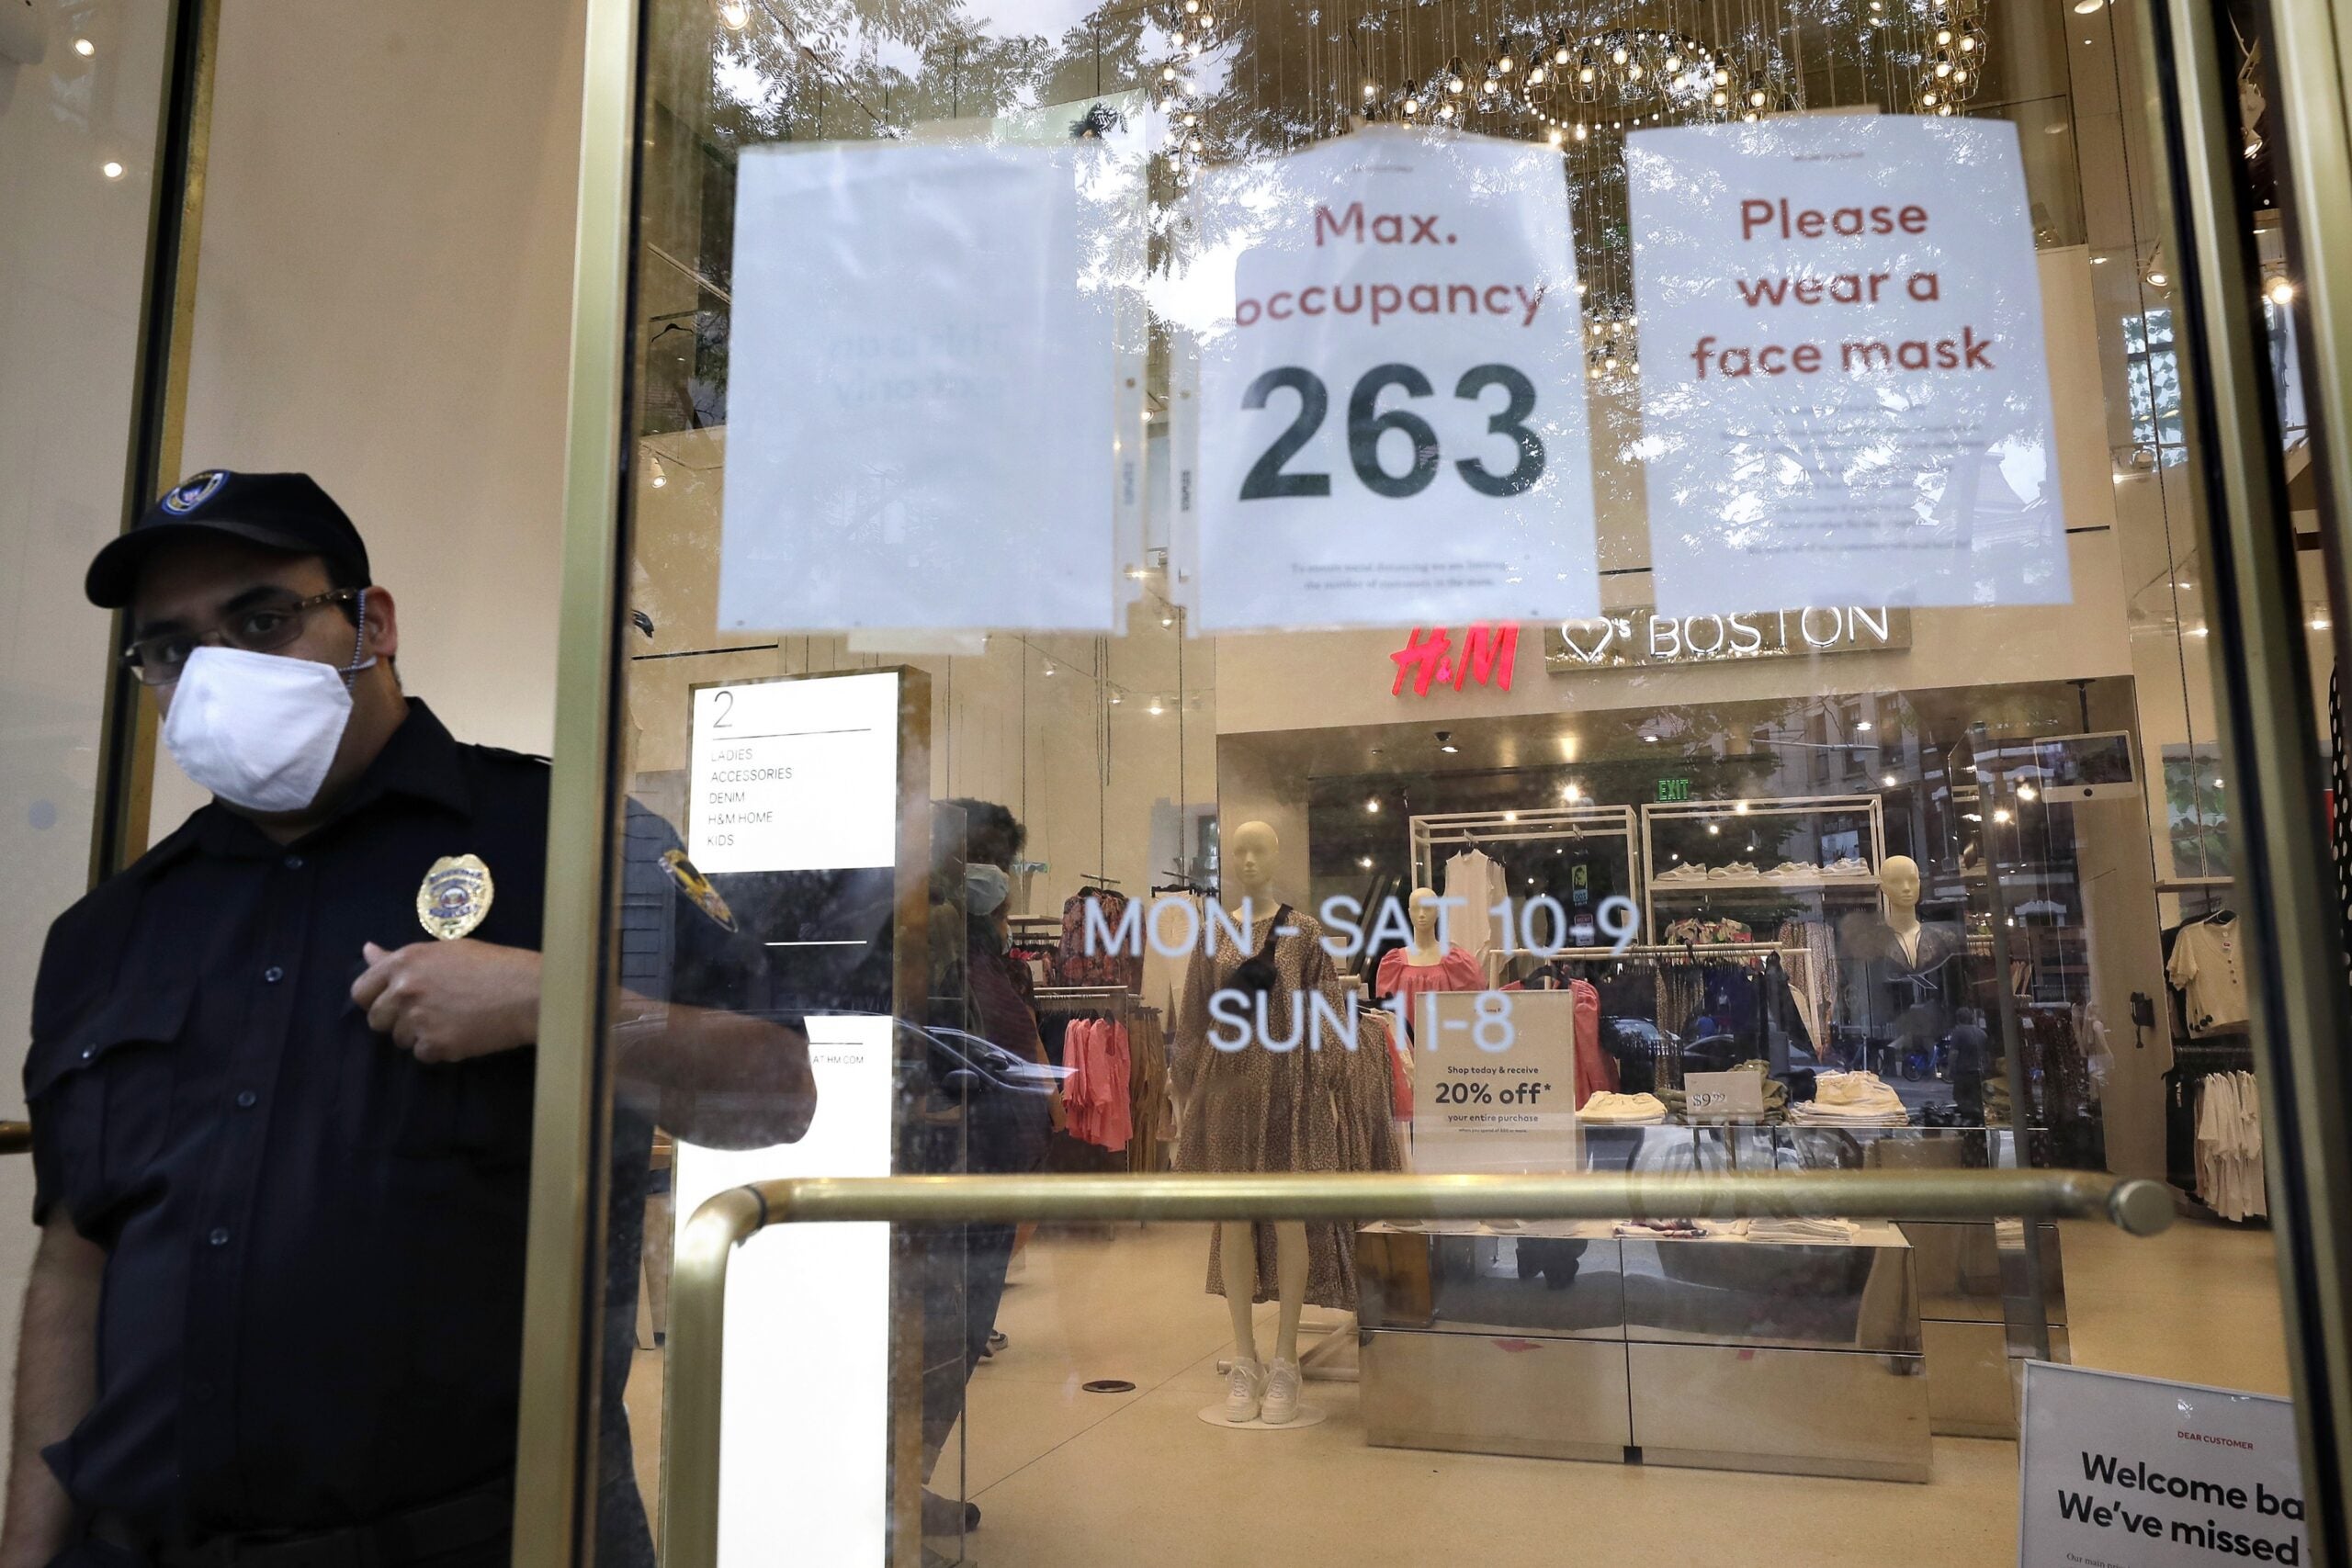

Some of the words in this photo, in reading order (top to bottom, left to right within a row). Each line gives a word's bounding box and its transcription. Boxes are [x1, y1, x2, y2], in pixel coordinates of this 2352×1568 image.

[1314, 201, 1458, 247] Max.
[1739, 198, 1928, 241] Please
[1736, 268, 1890, 310] wear
[1907, 271, 1940, 302] a
[1235, 281, 1545, 328] occupancy
[1690, 335, 1822, 380] face
[1842, 326, 1997, 372] mask
[1238, 361, 1545, 502] 263
[1390, 620, 1521, 697] H&M
[713, 691, 734, 728] 2
[711, 749, 753, 761] LADIES
[711, 767, 793, 783] ACCESSORIES
[1658, 779, 1689, 800] EXIT
[709, 792, 745, 804] DENIM
[708, 813, 735, 825] H&M
[739, 811, 773, 823] HOME
[707, 834, 734, 846] KIDS
[1083, 895, 1254, 958] MON
[1317, 895, 1470, 958] SAT
[1487, 895, 1640, 957] 10-9
[1207, 989, 1360, 1053] SUN
[1385, 989, 1515, 1053] 11-8
[827, 1055, 864, 1064] HMCOM
[1448, 1066, 1469, 1076] Shop
[1471, 1066, 1496, 1076] today
[1435, 1082, 1492, 1104] 20%
[1498, 1113, 1539, 1122] purchase
[2177, 1430, 2202, 1442] DEAR
[2203, 1435, 2254, 1450] CUSTOMER
[2081, 1450, 2248, 1510] Welcome
[2058, 1490, 2163, 1538] We've
[2172, 1519, 2300, 1567] missed
[2066, 1552, 2083, 1563] Our
[2085, 1558, 2106, 1568] main
